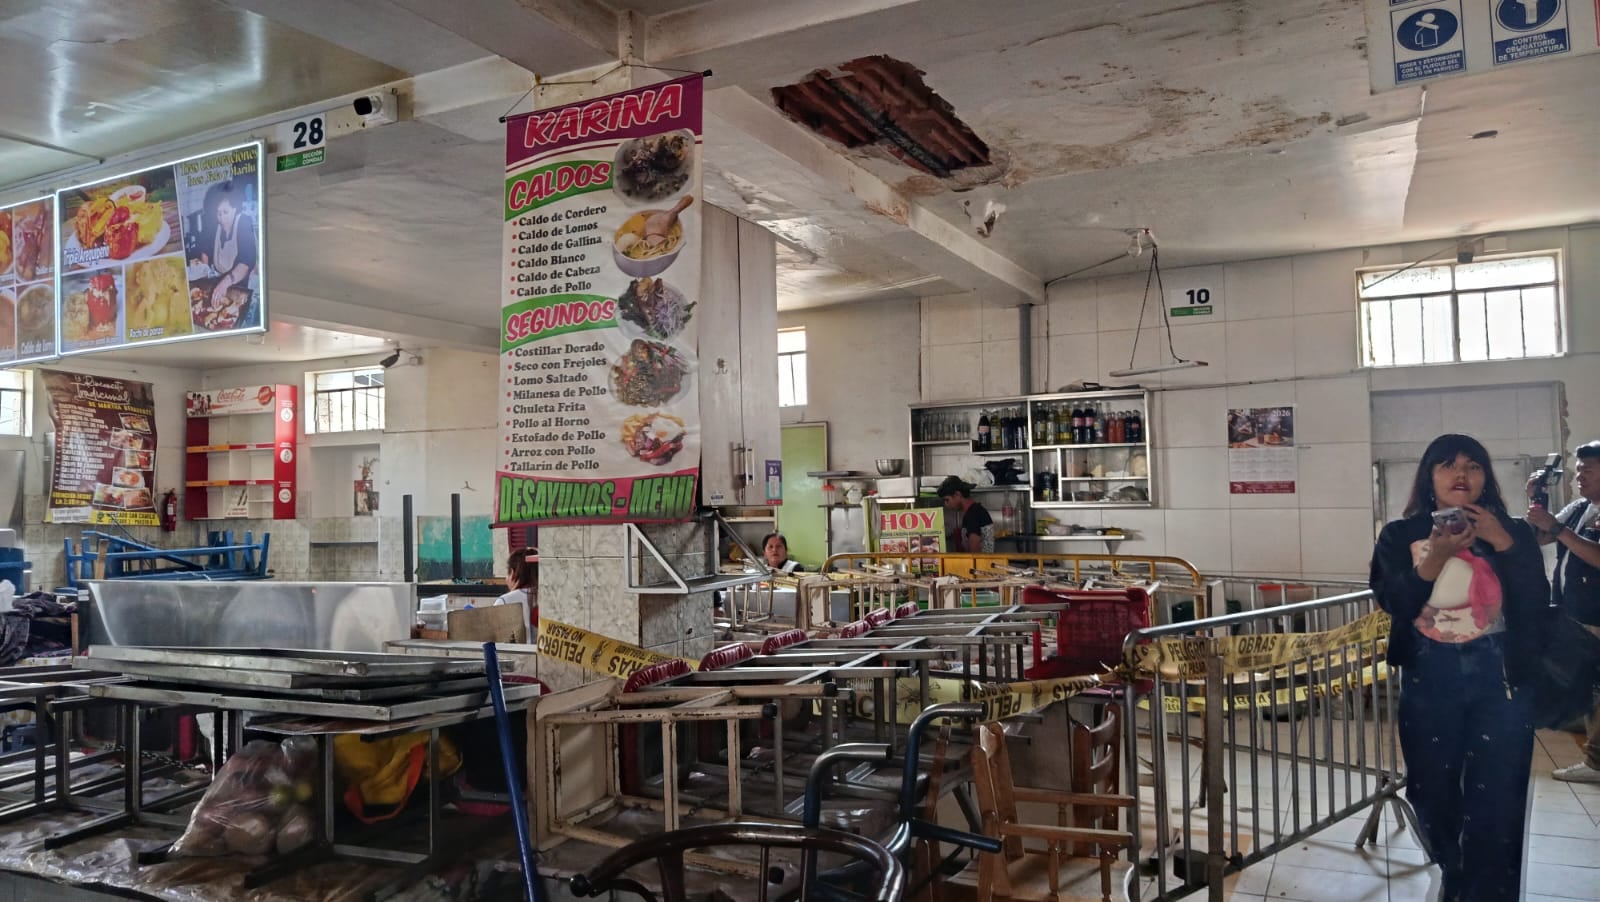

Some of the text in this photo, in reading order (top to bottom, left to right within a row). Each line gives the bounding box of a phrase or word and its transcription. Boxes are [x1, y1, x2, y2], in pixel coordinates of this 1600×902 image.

[1512, 33, 1548, 46] CONTROL
[1498, 44, 1564, 62] DE TEMPERATURA
[525, 83, 682, 148] KARINA
[293, 117, 324, 149] 28
[509, 162, 611, 210] CALDOS
[519, 205, 607, 227] Caldo de Cordero
[518, 222, 598, 242] Caldo de Lomos
[518, 235, 602, 255] Caldo de Gallina
[518, 253, 586, 268] Caldo Blanco
[517, 264, 600, 282] Caldo de Cabeza
[517, 282, 592, 297] Caldo de Pollo
[1186, 288, 1210, 305] 10
[505, 300, 614, 342] SEGUNDOS
[515, 342, 605, 358] Costillar Dorado
[514, 357, 607, 372] Seco con Frejoles
[514, 373, 588, 386] Lomo Saltado
[513, 386, 606, 400] Milanesa de Pollo
[512, 402, 586, 414] Chuleta Frita
[1272, 409, 1290, 417] 2026
[512, 416, 590, 428] Pollo al Horno
[512, 430, 606, 443] Estofado de Pollo
[510, 445, 595, 458] Arroz con Pollo
[510, 459, 600, 472] Tallarin de Pollo
[500, 477, 615, 522] DESAYUNOS
[628, 475, 694, 519] MENU
[880, 510, 936, 531] HOY
[546, 623, 586, 642] NO PASAR
[536, 635, 586, 664] PELIGRO
[1238, 635, 1277, 654] OBRAS
[608, 654, 644, 678] RAS
